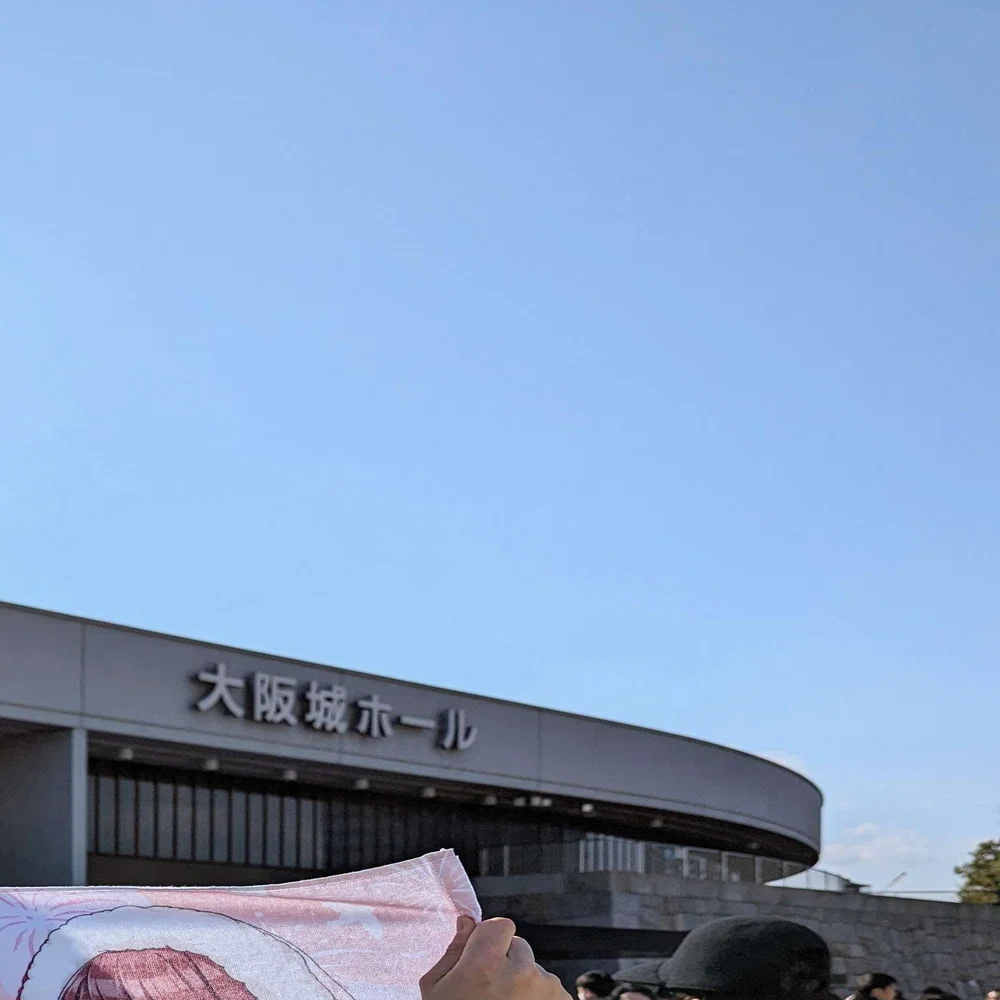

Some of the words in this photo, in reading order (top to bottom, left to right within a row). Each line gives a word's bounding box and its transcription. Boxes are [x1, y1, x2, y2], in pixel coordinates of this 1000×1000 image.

[196, 664, 477, 749] 大阪城ホール
